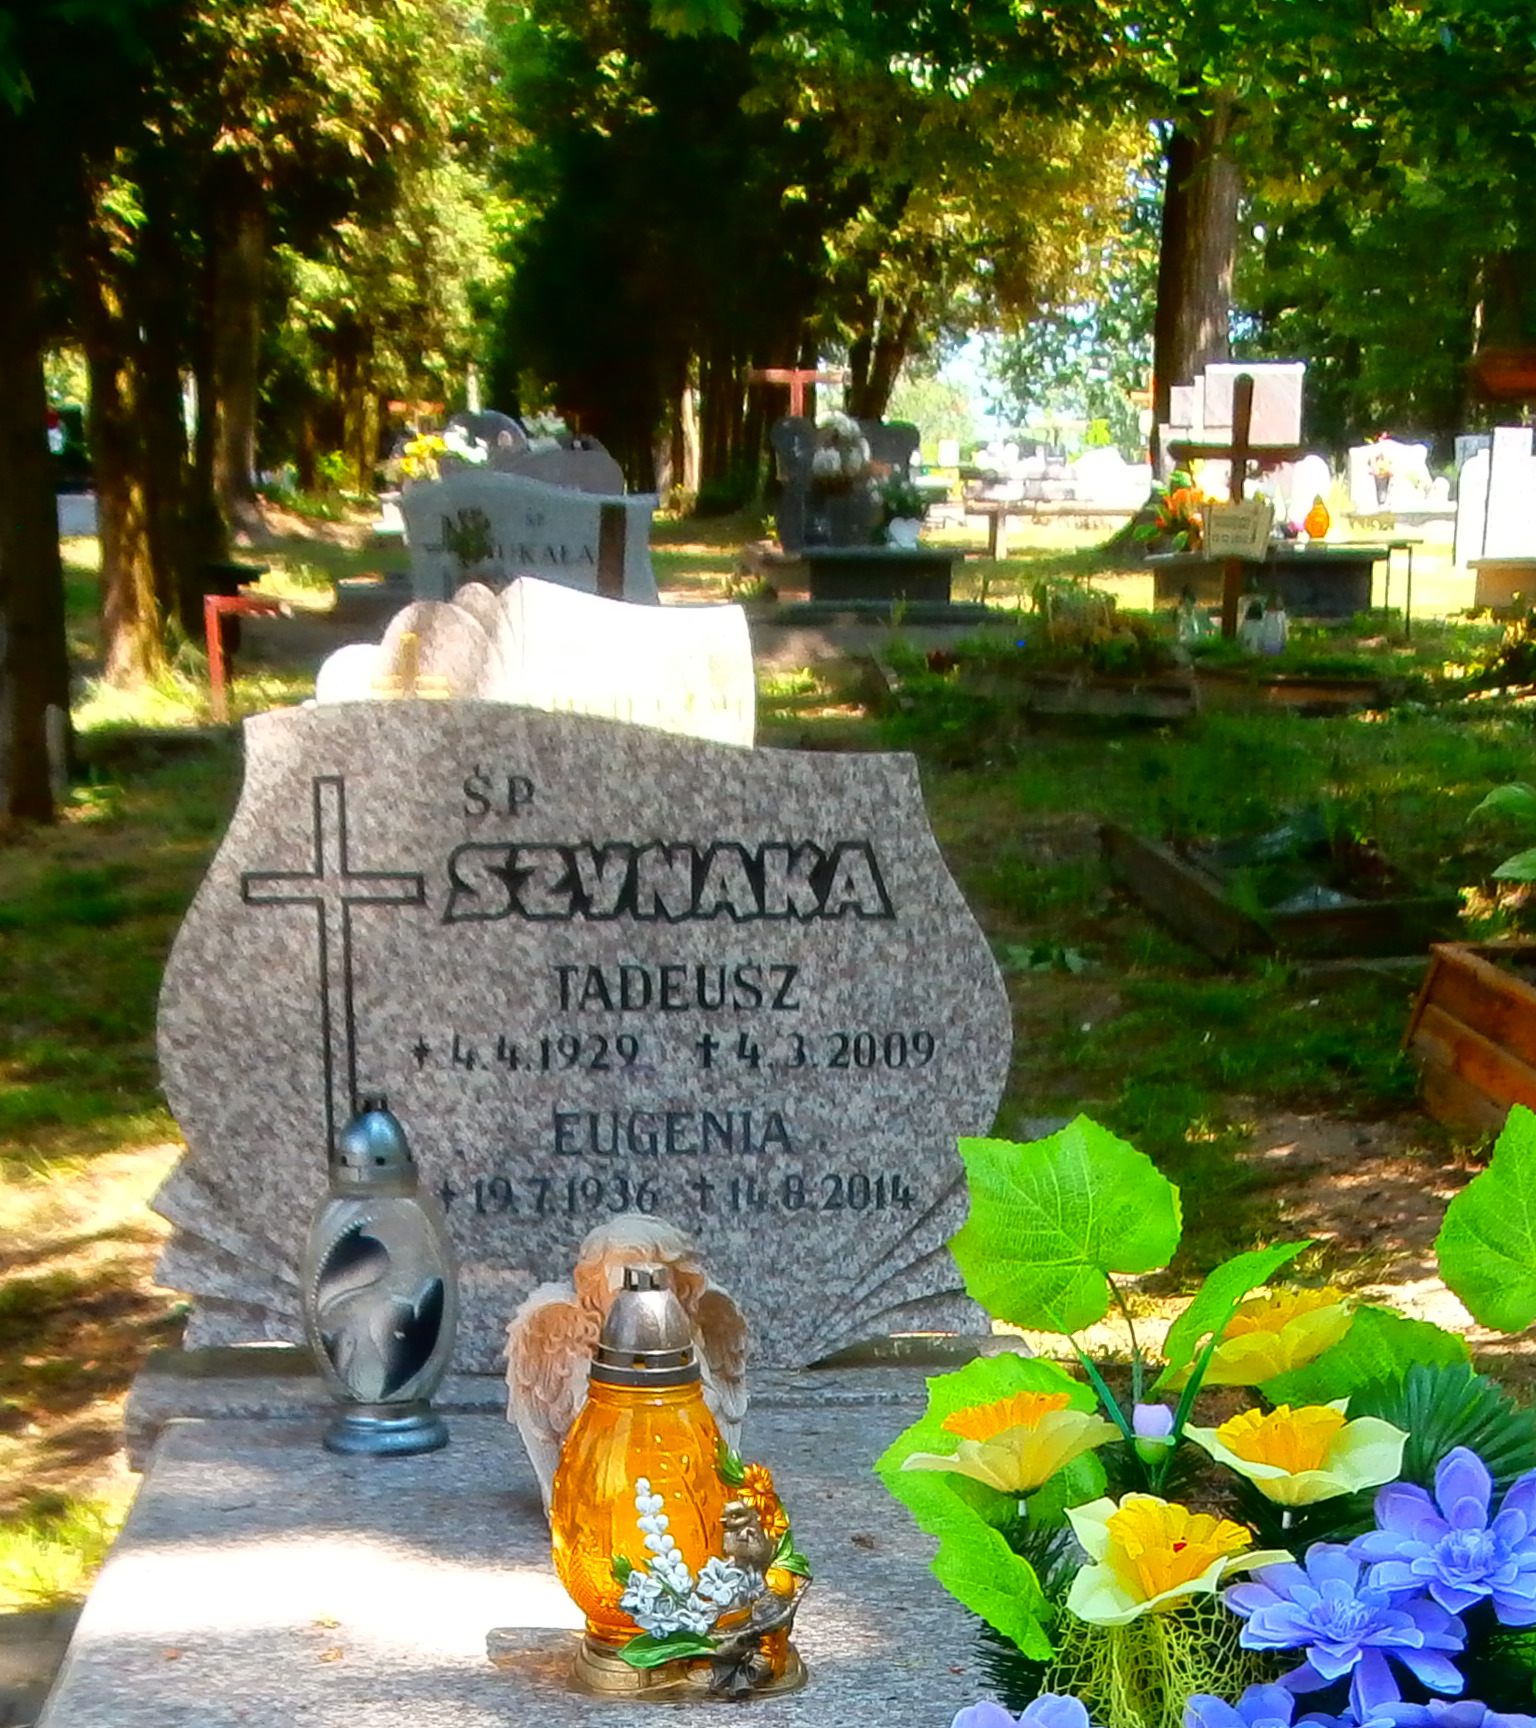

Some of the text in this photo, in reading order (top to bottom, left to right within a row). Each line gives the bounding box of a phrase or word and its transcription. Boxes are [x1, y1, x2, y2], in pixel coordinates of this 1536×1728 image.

[443, 839, 896, 924] SZYNAKA
[553, 963, 801, 1012] TADEUSZ
[554, 1107, 796, 1157] EUGENIA
